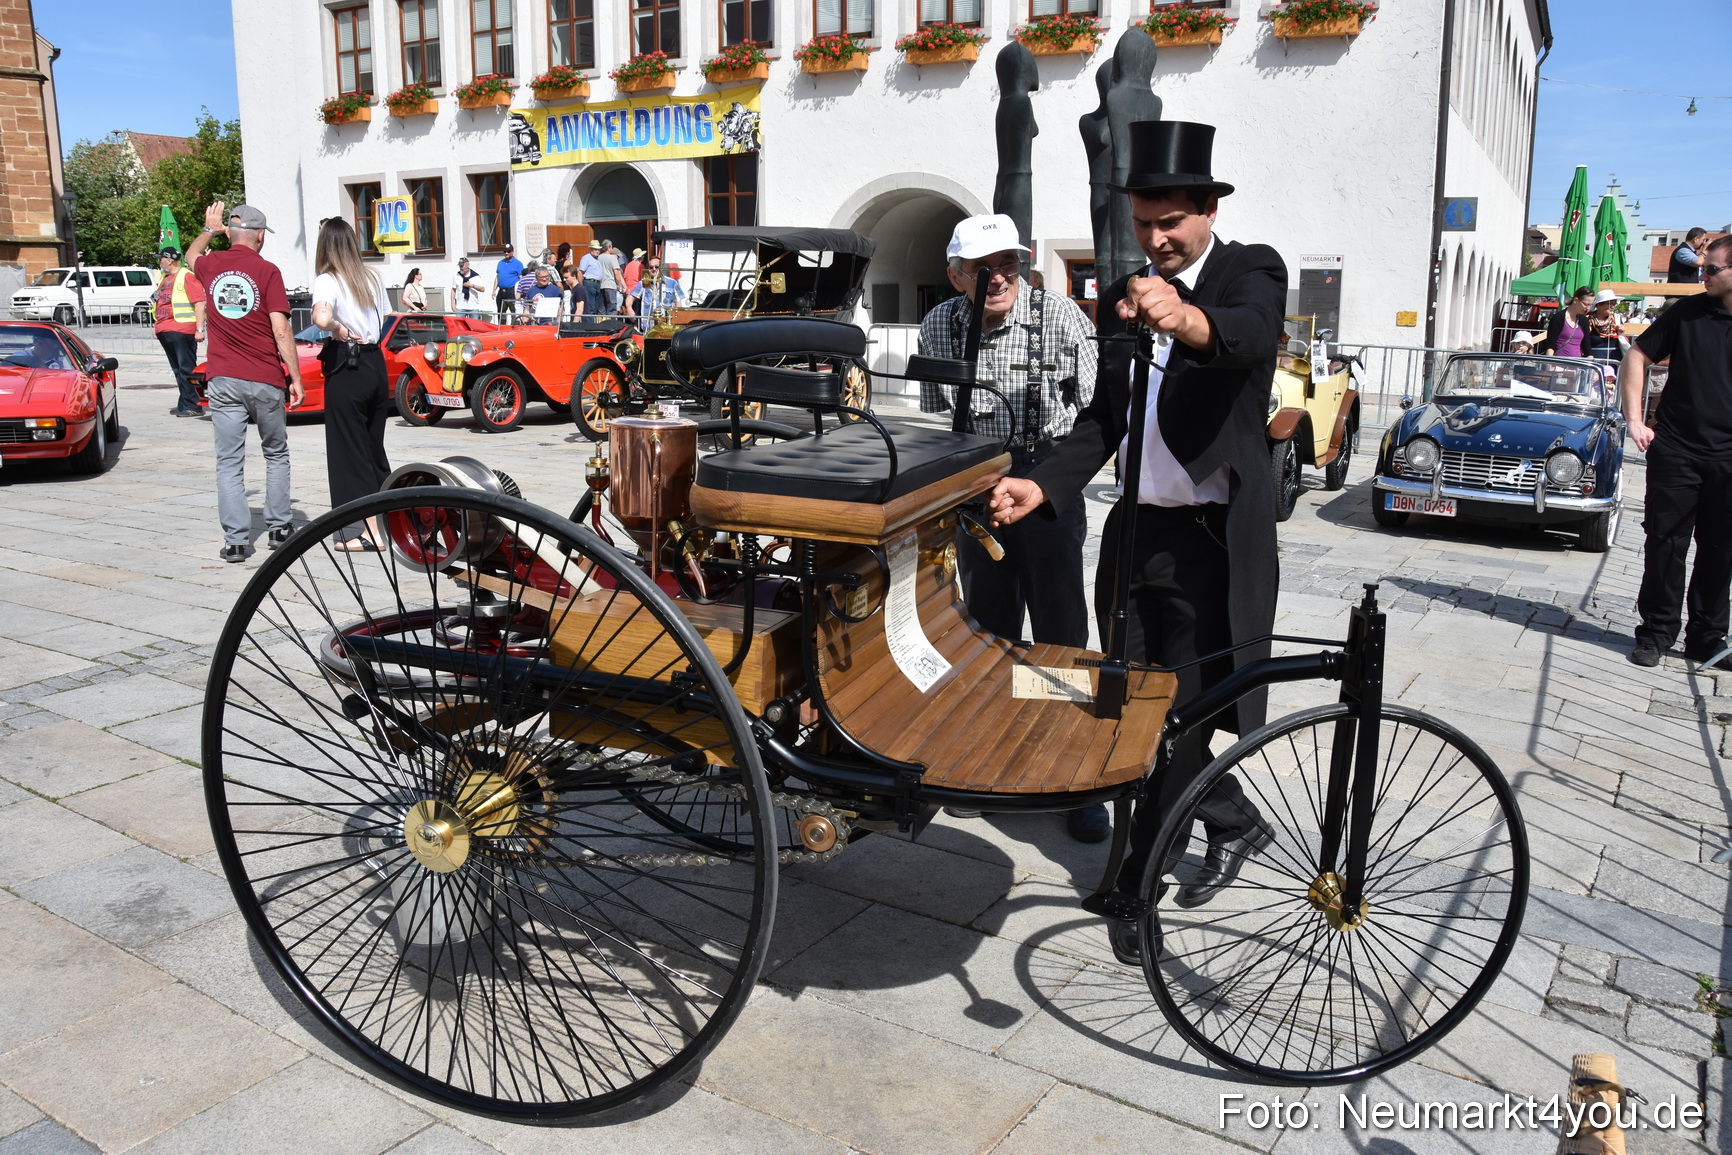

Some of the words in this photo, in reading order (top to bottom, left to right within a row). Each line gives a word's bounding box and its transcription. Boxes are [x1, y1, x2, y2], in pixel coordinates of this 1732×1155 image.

[546, 102, 714, 155] ANMELDUNG
[377, 199, 409, 235] WC
[1393, 496, 1416, 510] DON
